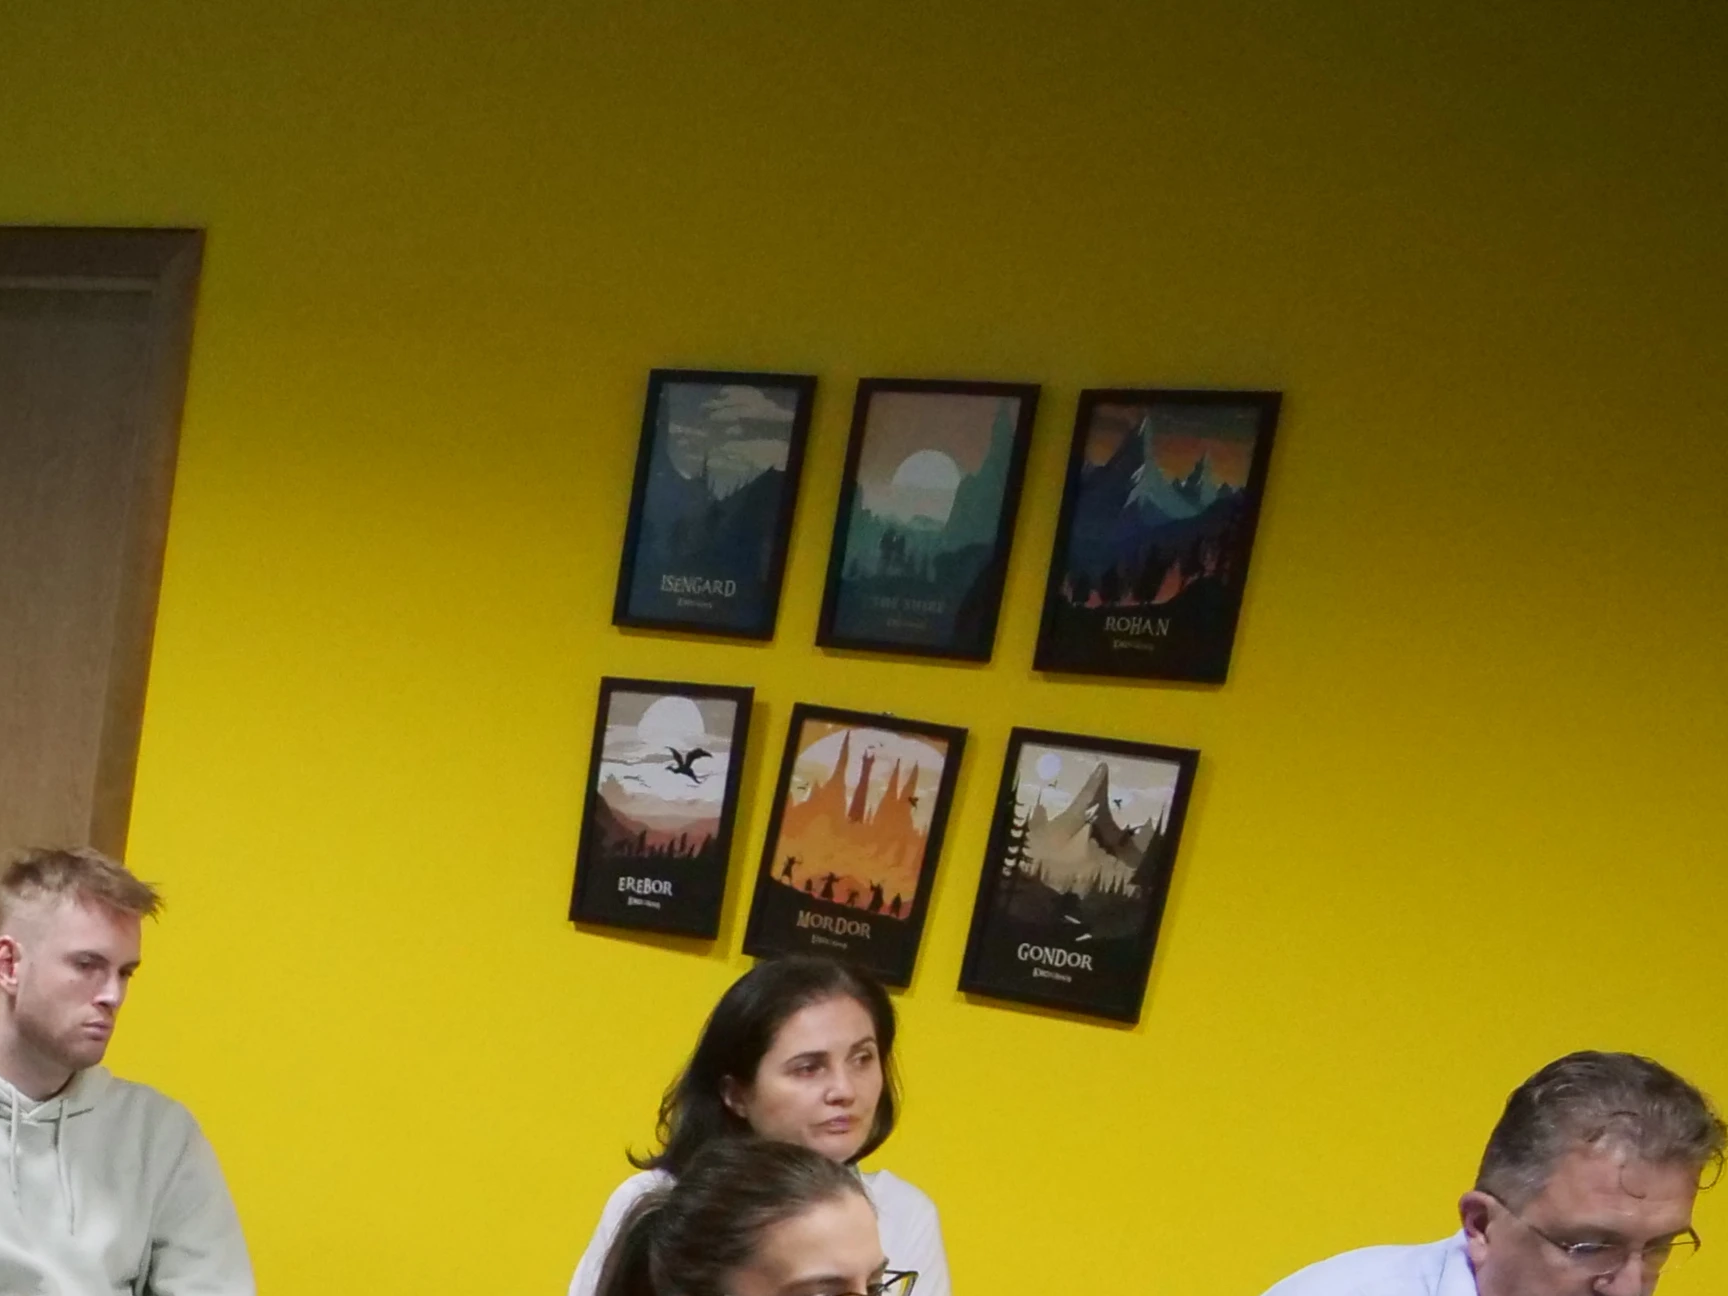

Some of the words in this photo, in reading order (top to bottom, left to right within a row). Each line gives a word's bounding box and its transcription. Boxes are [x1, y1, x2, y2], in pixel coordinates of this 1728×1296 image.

[661, 574, 737, 597] ISENGARD
[1104, 616, 1171, 636] ROHAN
[617, 876, 673, 897] EREBOR
[796, 909, 872, 939] MORDOR
[1017, 942, 1094, 971] GONDOR
